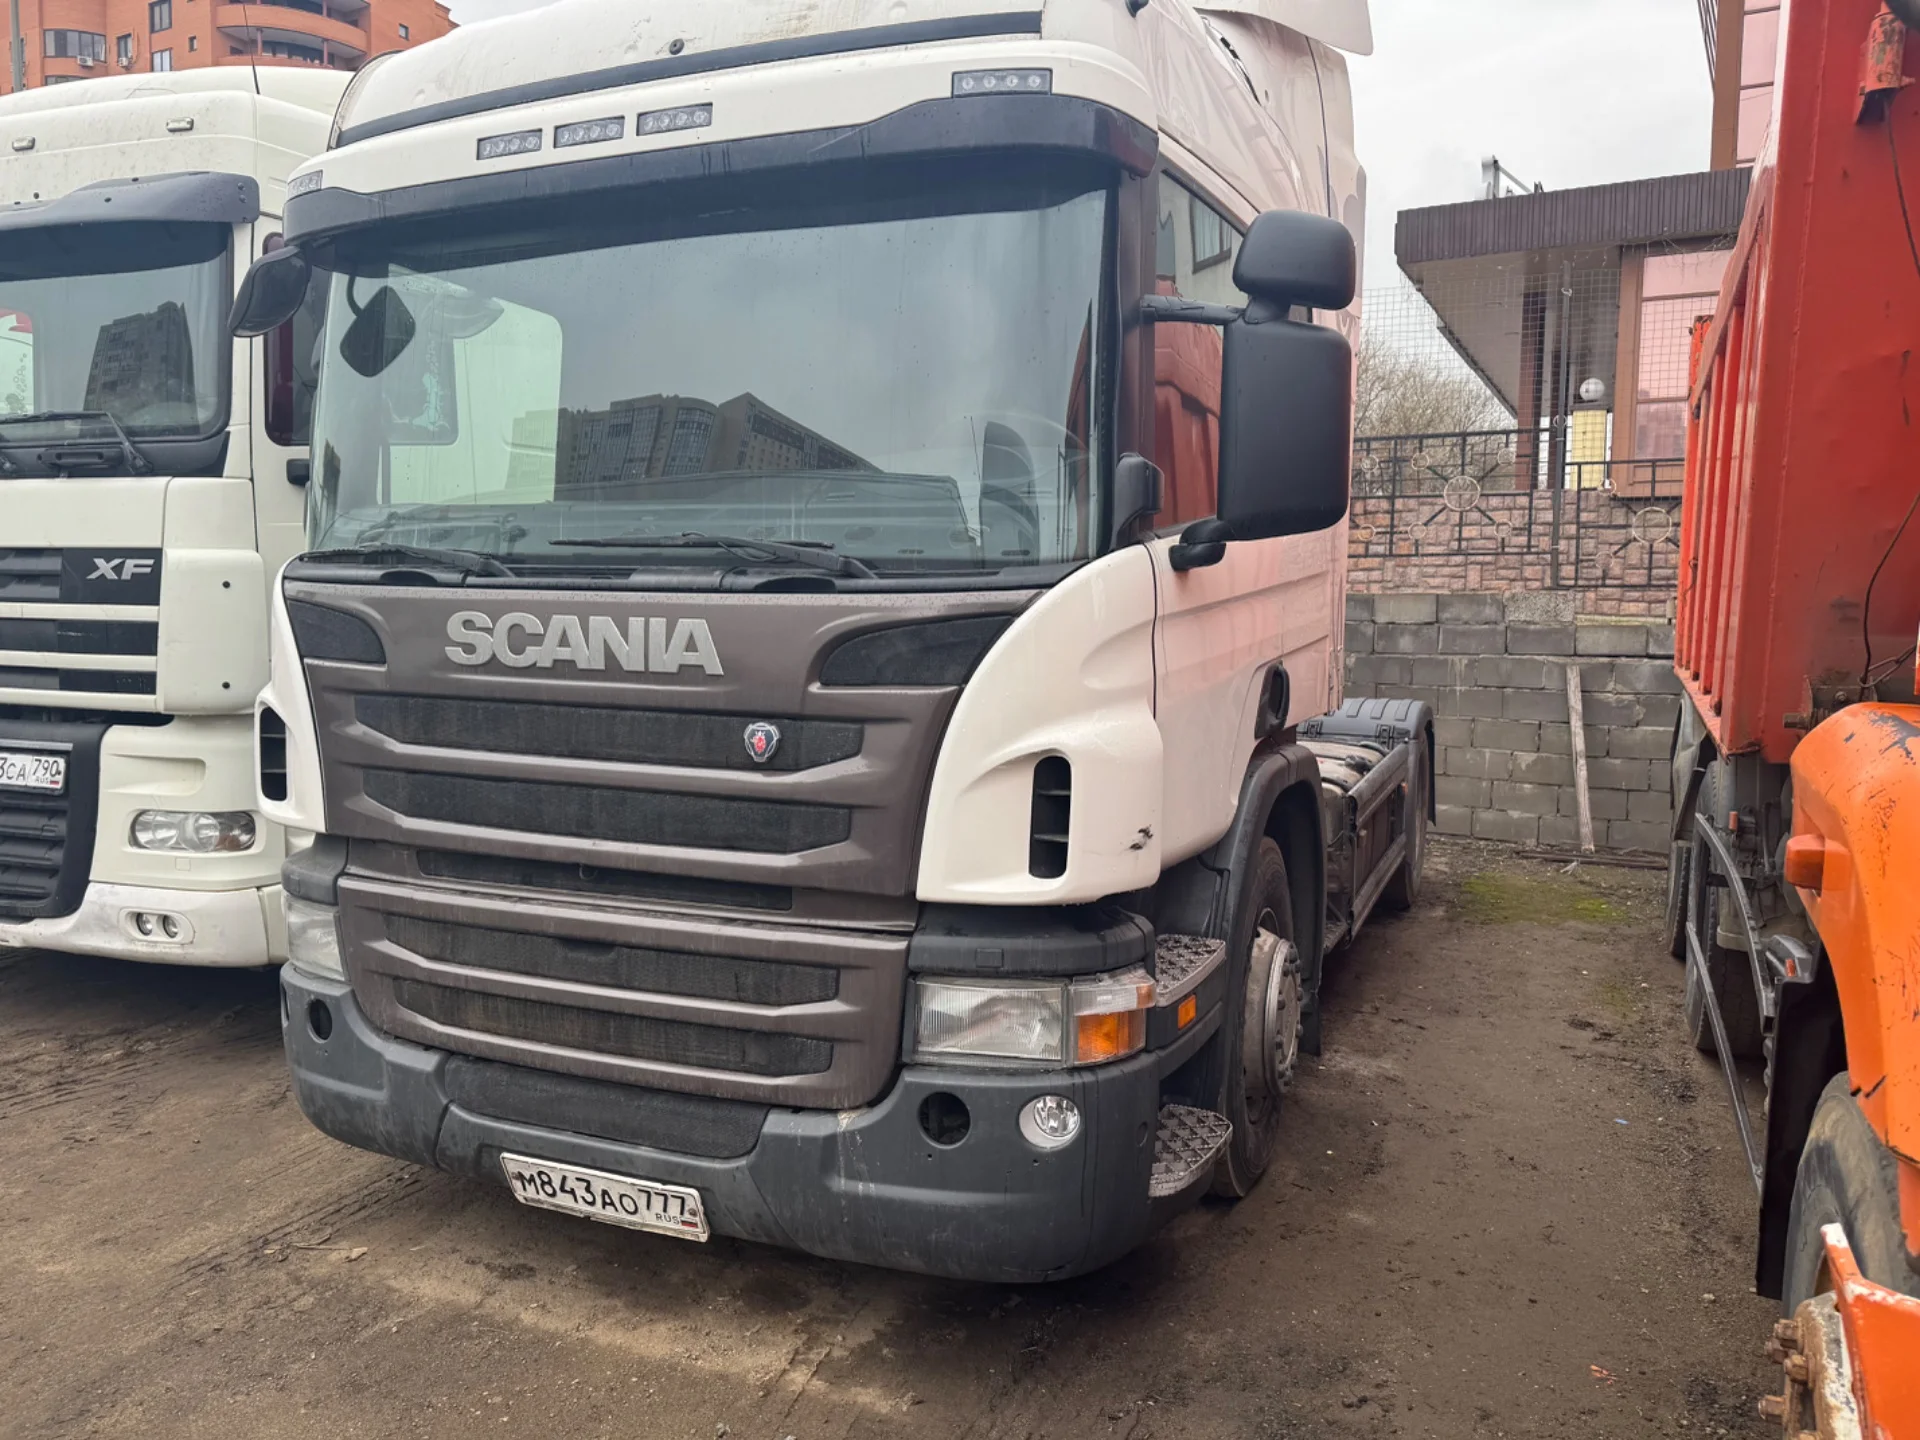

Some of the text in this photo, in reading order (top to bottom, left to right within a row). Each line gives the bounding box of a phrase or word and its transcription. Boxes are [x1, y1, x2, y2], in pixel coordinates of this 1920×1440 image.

[86, 558, 155, 580] XF
[445, 611, 724, 675] SCANIA
[655, 1213, 680, 1225] RUS
